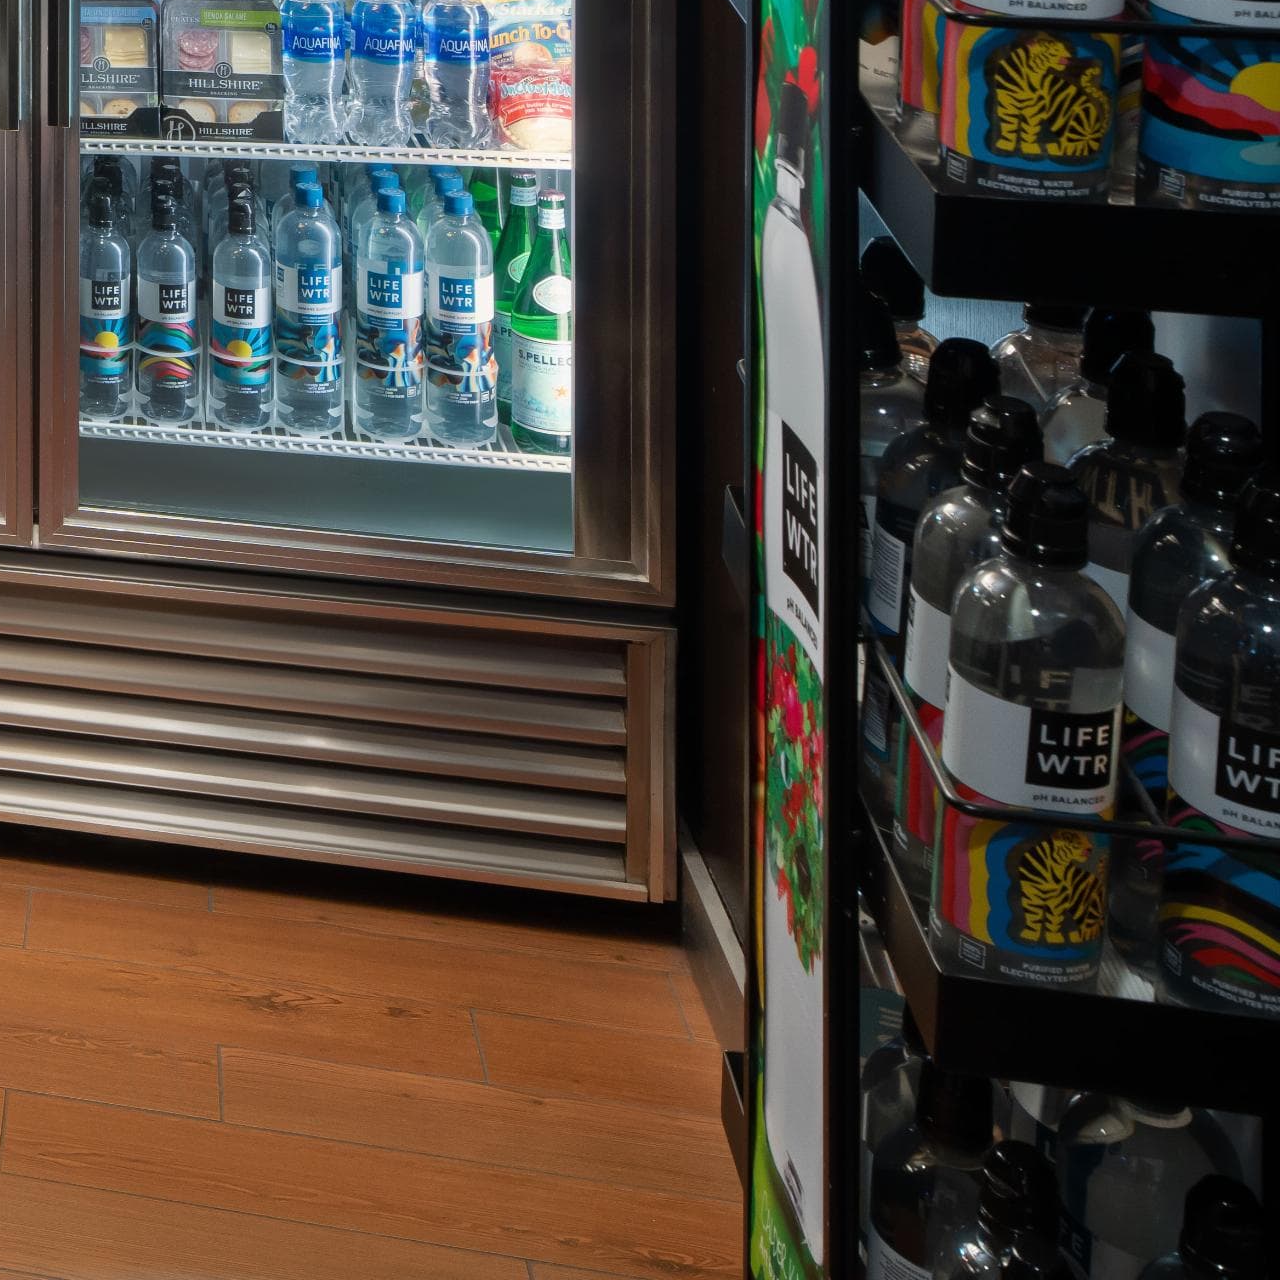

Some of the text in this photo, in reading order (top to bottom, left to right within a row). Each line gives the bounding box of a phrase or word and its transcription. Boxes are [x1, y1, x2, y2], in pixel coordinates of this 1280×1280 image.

[1026, 0, 1089, 13] BALANCED
[293, 35, 341, 51] AQUAFINA
[490, 25, 530, 49] unch
[364, 36, 416, 53] AQUAFINA
[440, 38, 490, 54] AQUAFINA
[81, 74, 137, 83] LLSHIRE
[189, 78, 260, 90] HILLSHIRE
[199, 127, 253, 136] HILLSHIRE
[977, 178, 1046, 196] ELECTROLYTES
[1047, 188, 1065, 197] FOR
[997, 174, 1073, 189] PURIFIED WATER
[301, 275, 330, 286] LIFE
[370, 279, 400, 290] LIFE
[94, 286, 119, 295] LIFE
[162, 289, 187, 299] LIFE
[301, 288, 330, 299] WTR
[441, 282, 473, 294] LIFE
[94, 297, 119, 306] WTR
[227, 292, 253, 303] LIFE
[370, 291, 400, 302] WTR
[441, 296, 473, 308] WTR
[162, 300, 187, 309] WTR
[227, 304, 253, 315] WTR
[785, 452, 817, 526] LIFE
[785, 508, 818, 587] WTR
[1040, 724, 1110, 747] LIFE
[1037, 751, 1109, 776] WTR
[1224, 764, 1280, 800] WT
[1032, 794, 1048, 803] pH
[1022, 962, 1063, 974] PURIFIED
[1000, 965, 1067, 984] ELECTROLYTES
